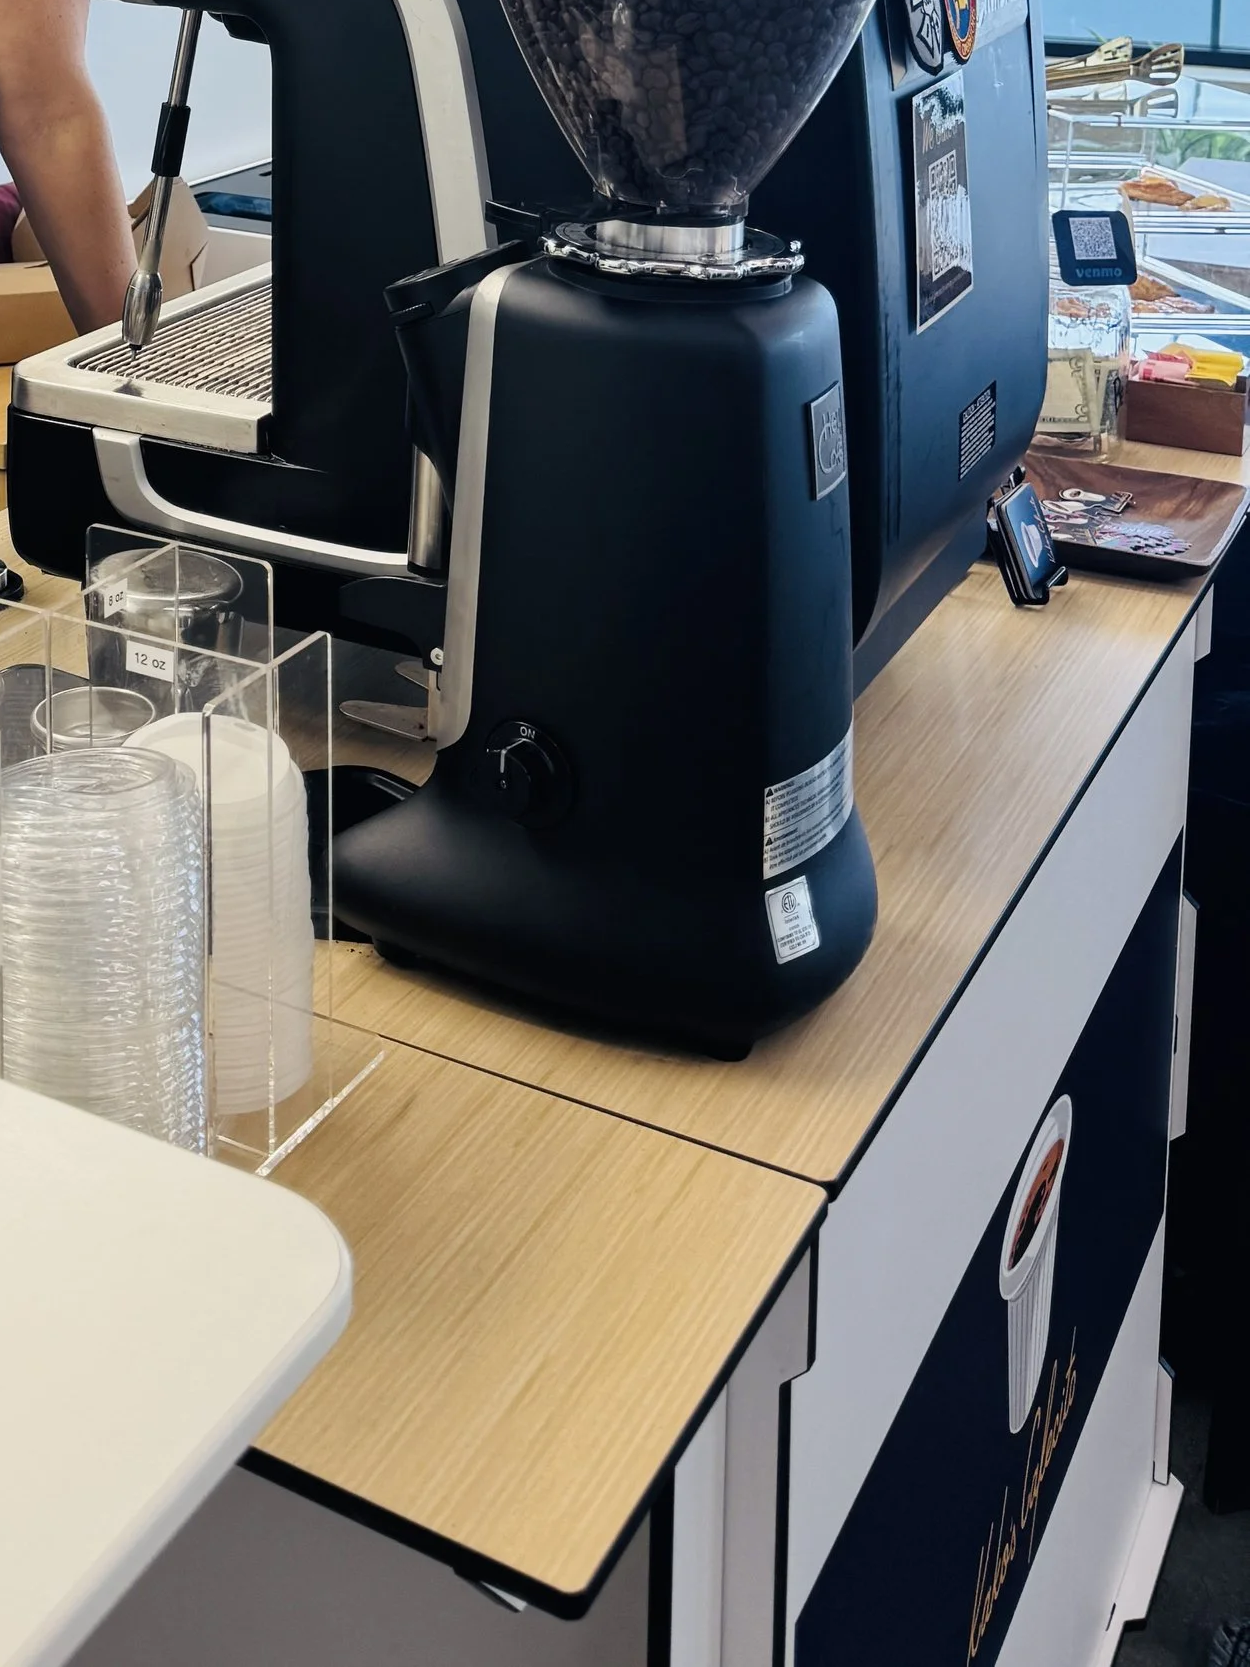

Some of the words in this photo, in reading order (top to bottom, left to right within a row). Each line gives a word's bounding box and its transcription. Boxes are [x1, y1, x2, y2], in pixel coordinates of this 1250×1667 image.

[1075, 267, 1123, 278] venmo
[108, 595, 114, 606] 8
[115, 591, 124, 603] oz
[134, 652, 148, 666] 12
[152, 659, 166, 671] oz
[519, 726, 536, 740] ON
